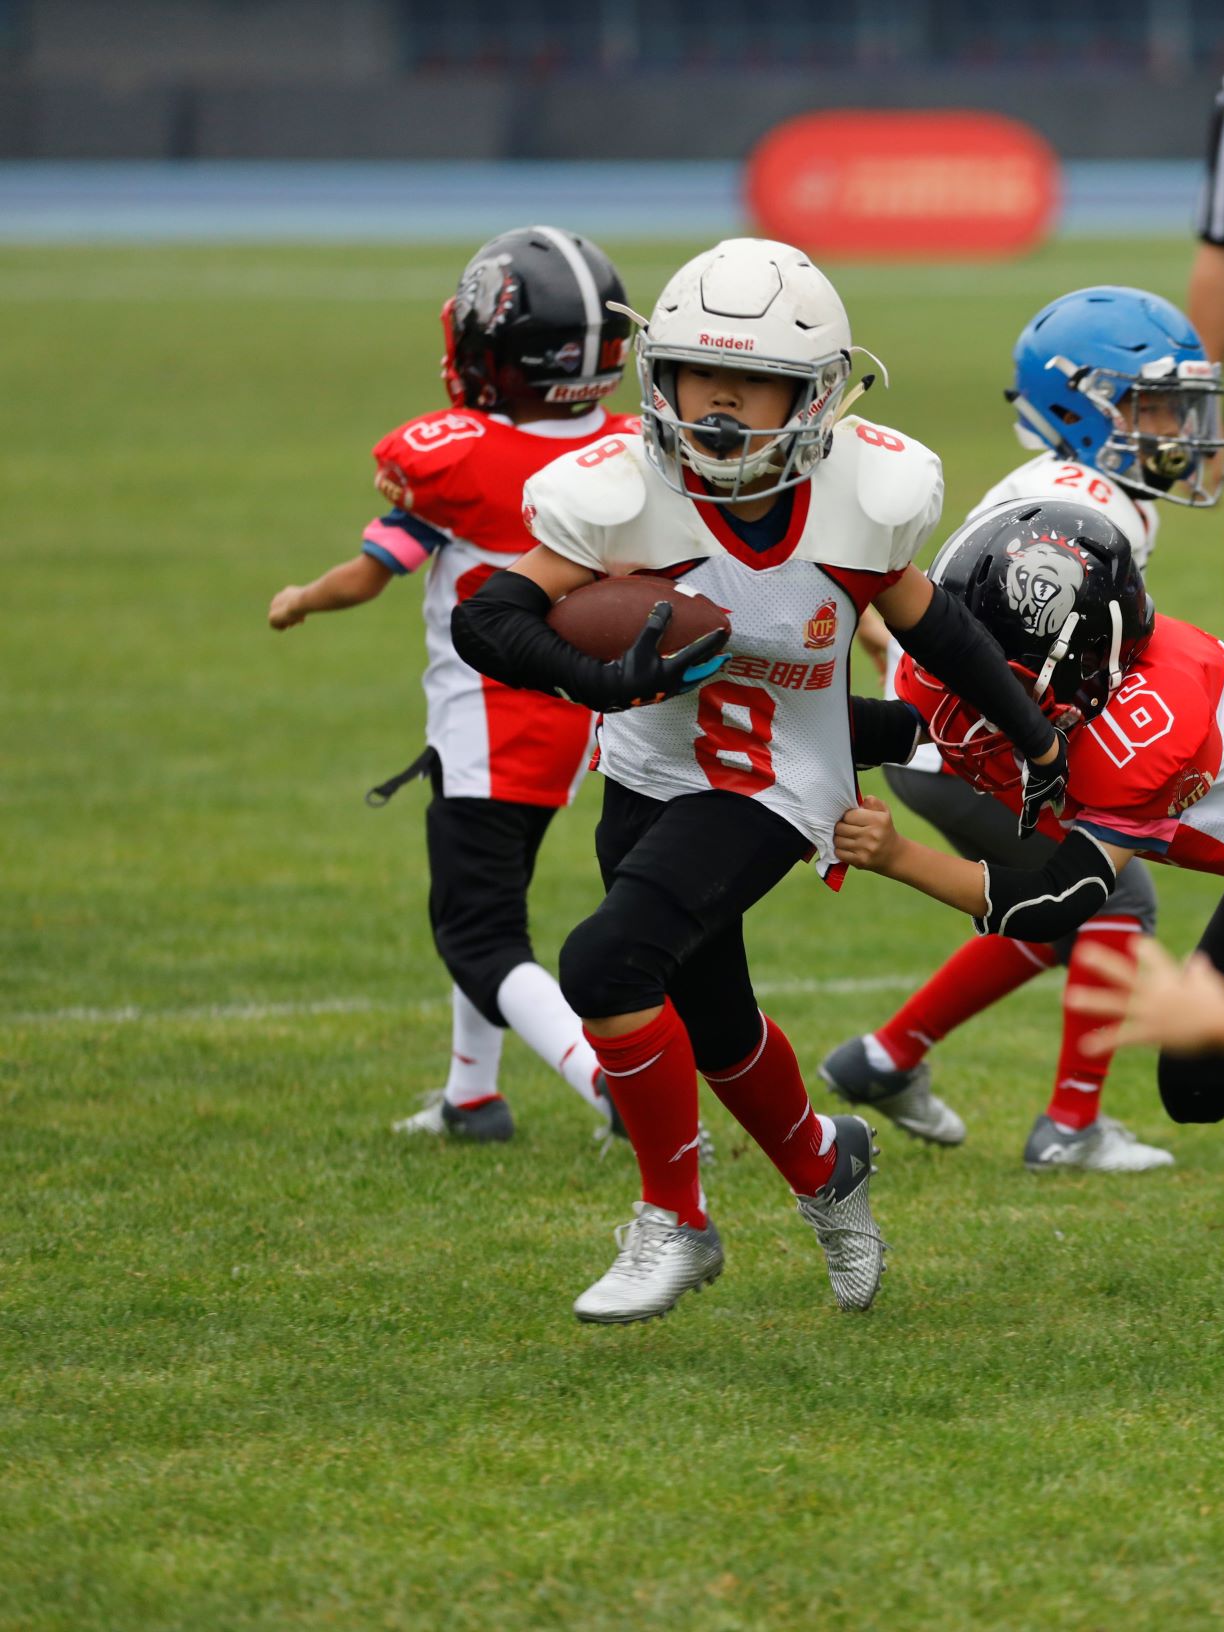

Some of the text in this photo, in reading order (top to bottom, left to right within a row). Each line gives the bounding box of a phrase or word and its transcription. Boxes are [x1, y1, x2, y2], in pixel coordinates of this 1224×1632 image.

[699, 334, 754, 350] Riddell
[855, 424, 905, 452] 8
[576, 439, 627, 468] 8
[1054, 465, 1113, 504] 26
[811, 619, 834, 637] YTF
[1086, 672, 1175, 769] 16
[694, 680, 777, 796] 8
[1178, 781, 1205, 809] YTF
